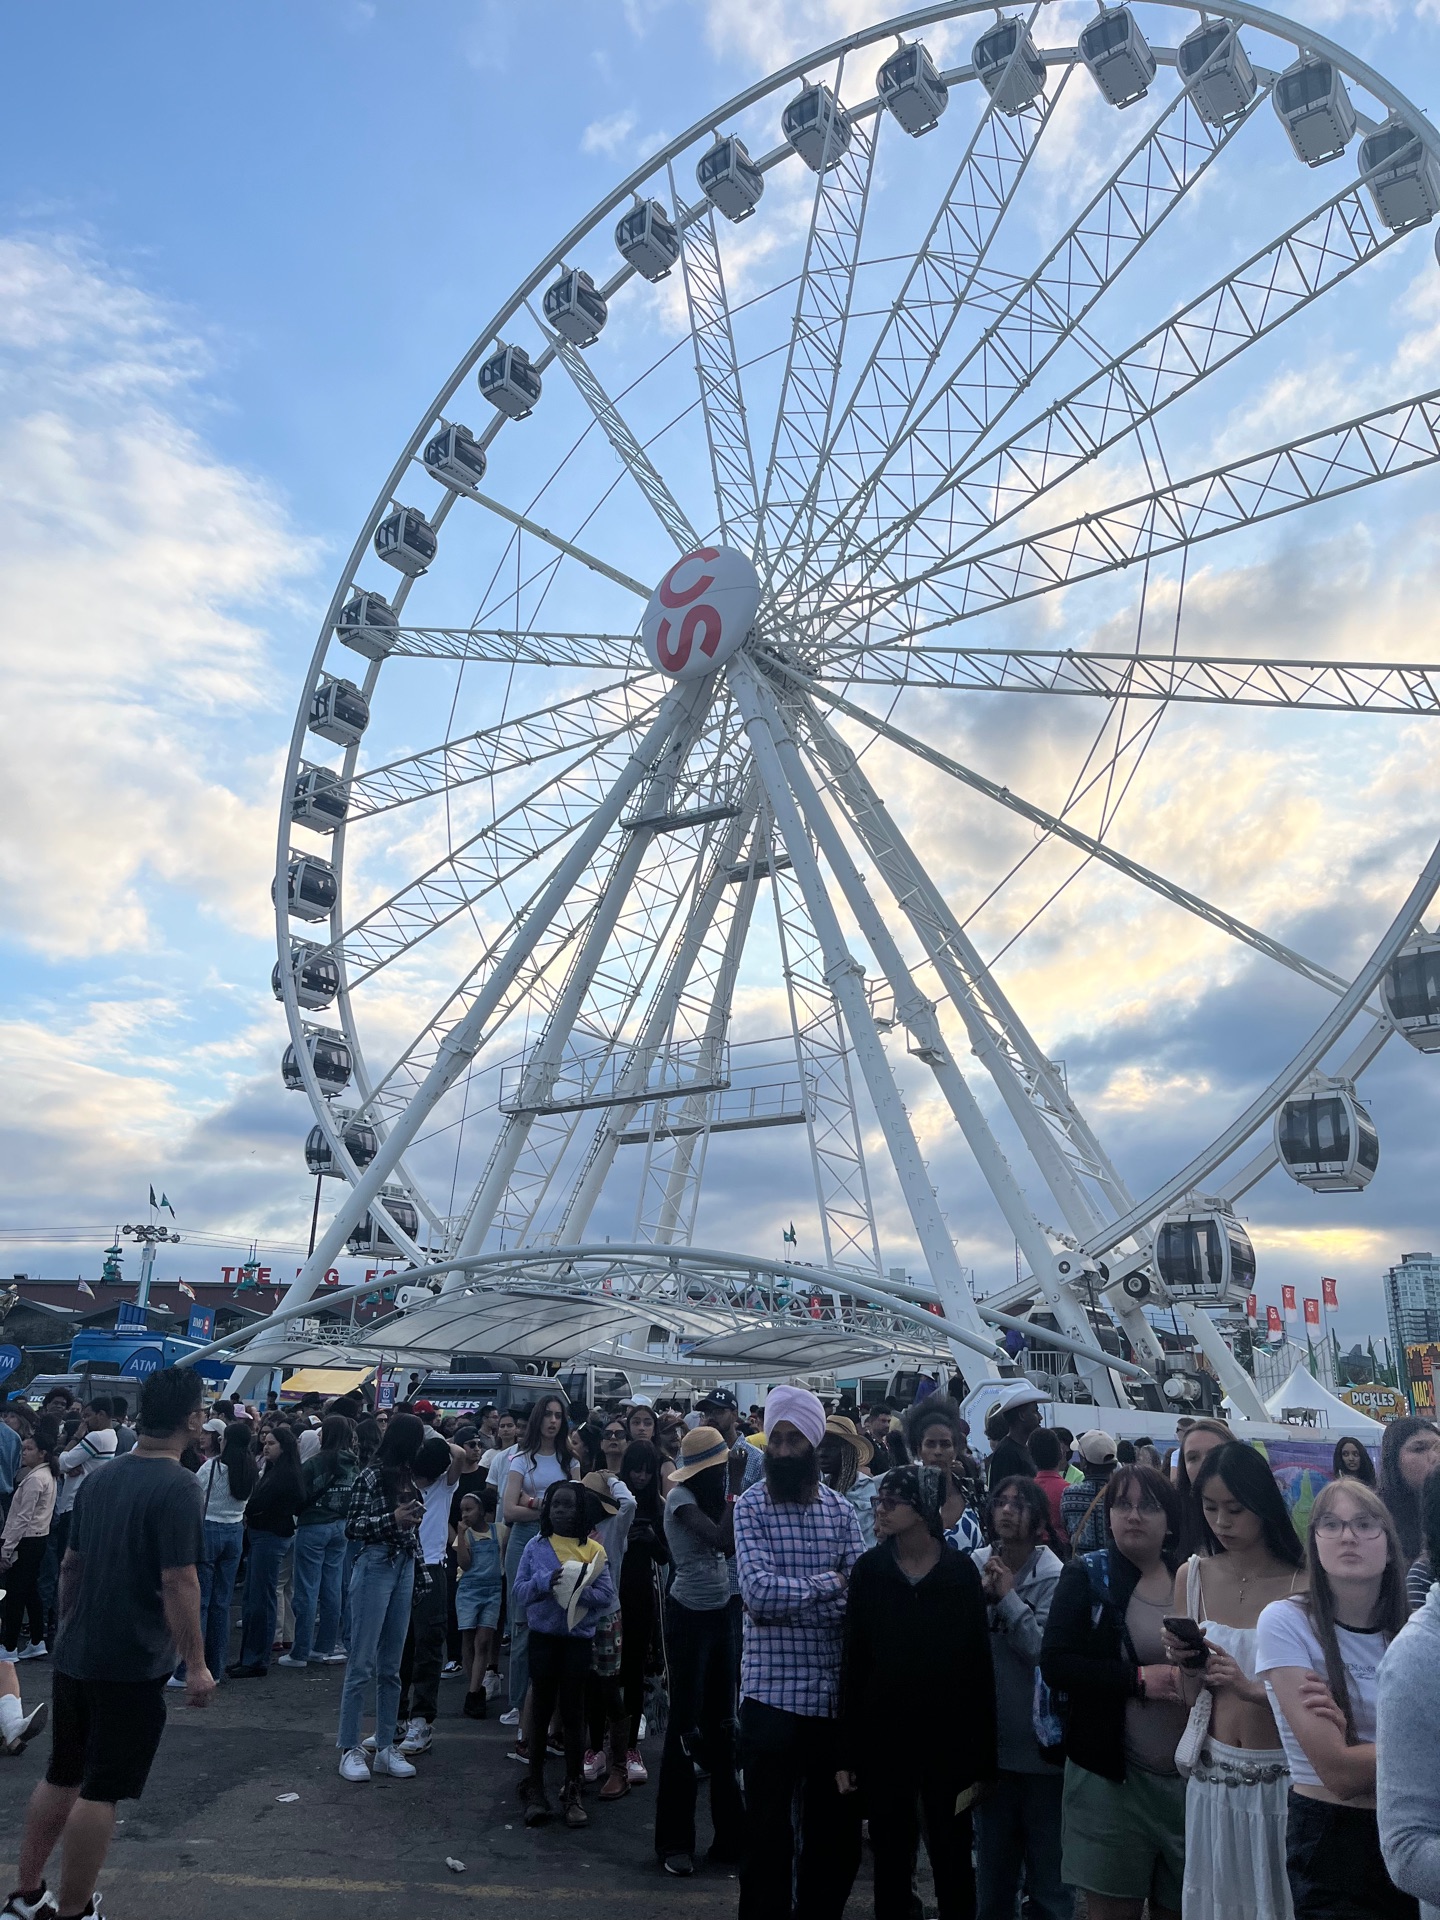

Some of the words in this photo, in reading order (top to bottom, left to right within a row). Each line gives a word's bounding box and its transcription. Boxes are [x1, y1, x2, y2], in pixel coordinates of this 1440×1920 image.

[192, 1316, 204, 1329] BMO
[0, 1355, 15, 1369] TM
[130, 1358, 157, 1372] ATM
[1422, 1356, 1432, 1375] BIG
[1352, 1392, 1395, 1406] PICKLES
